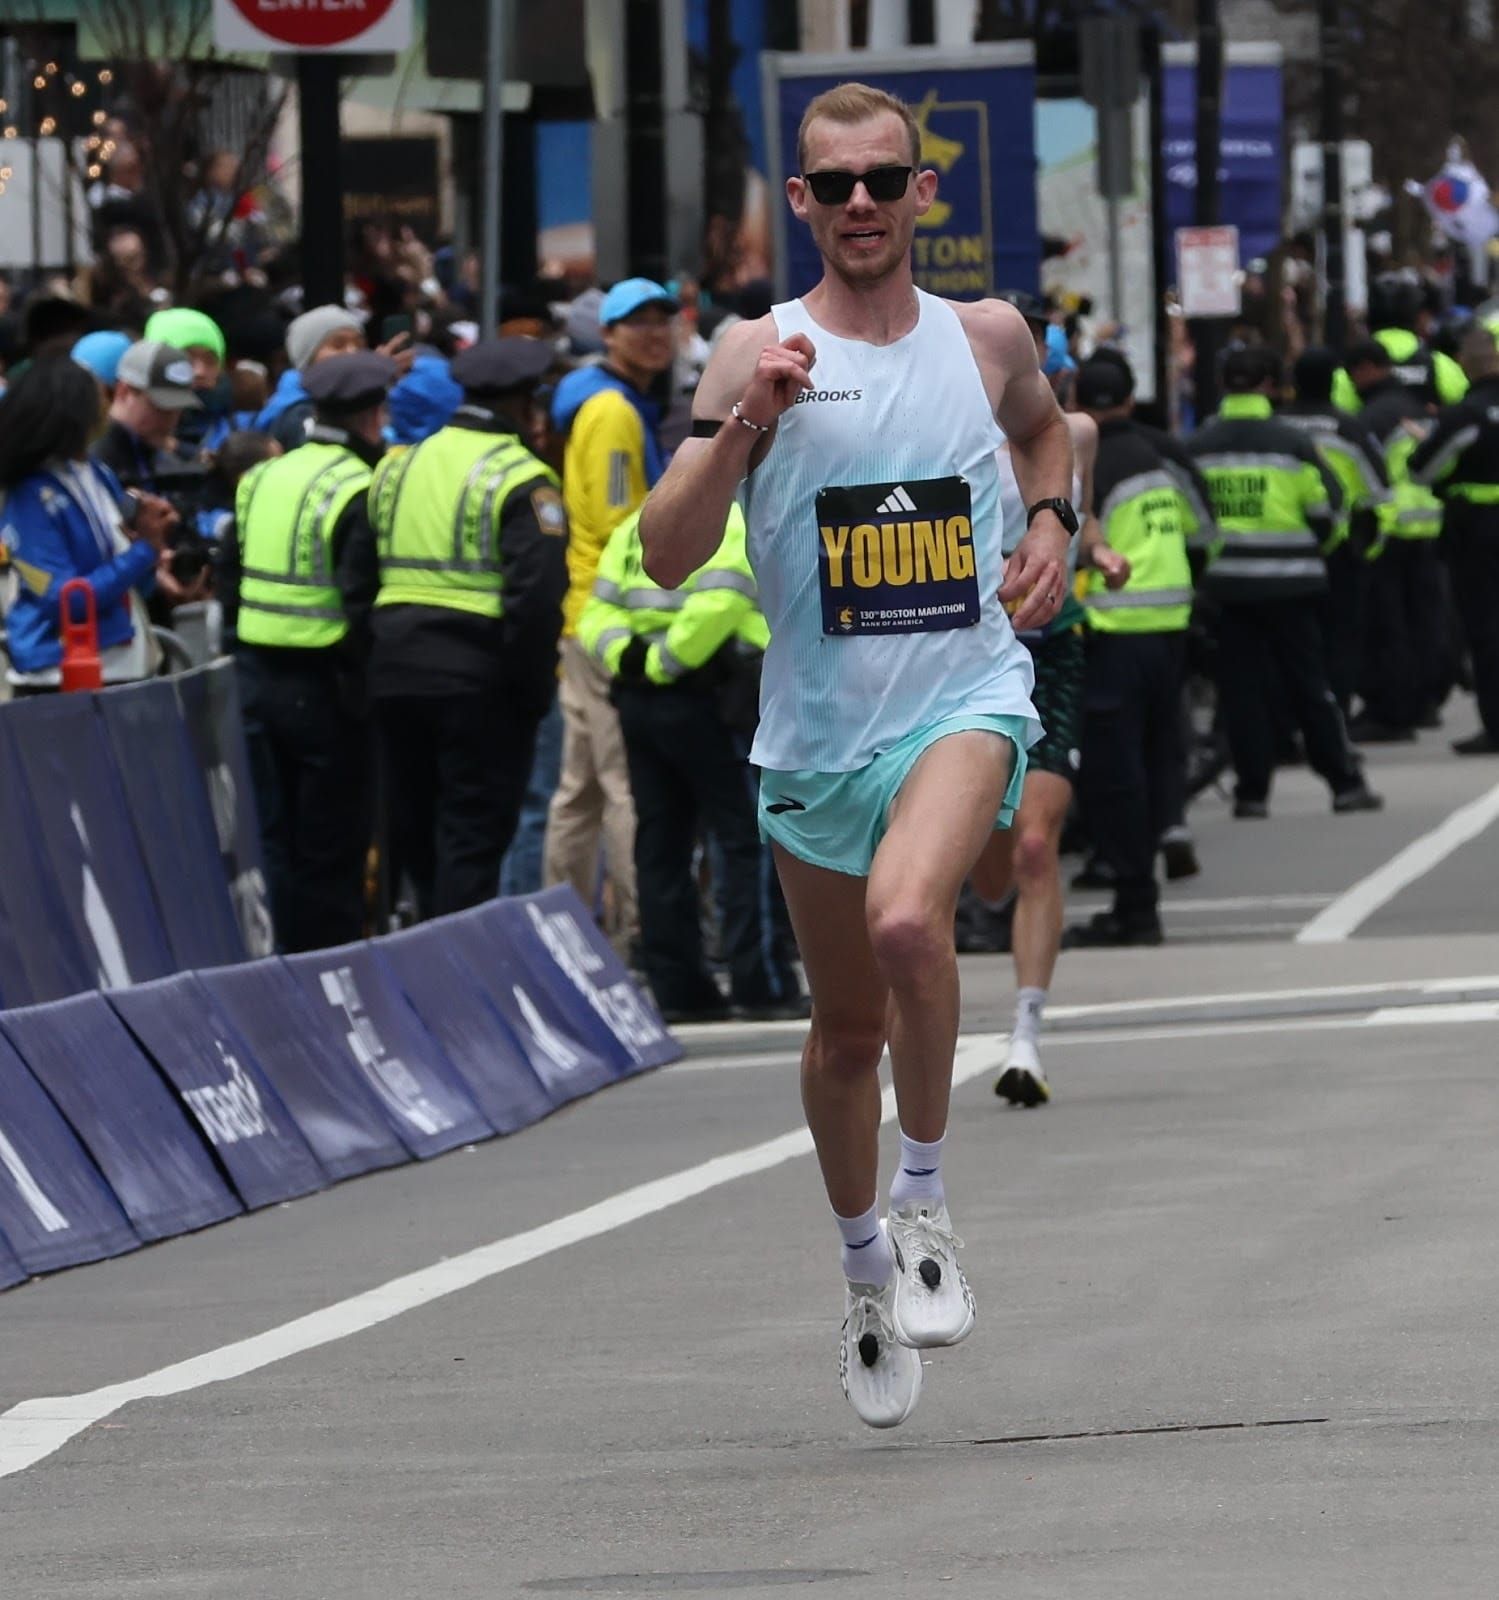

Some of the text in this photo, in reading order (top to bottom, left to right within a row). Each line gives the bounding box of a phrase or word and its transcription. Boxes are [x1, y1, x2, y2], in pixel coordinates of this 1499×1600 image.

[795, 389, 863, 404] BROOKS
[820, 515, 975, 588] YOUNG
[880, 608, 916, 619] BOSTON
[917, 602, 966, 617] MARATHON
[892, 618, 924, 626] AMERICA
